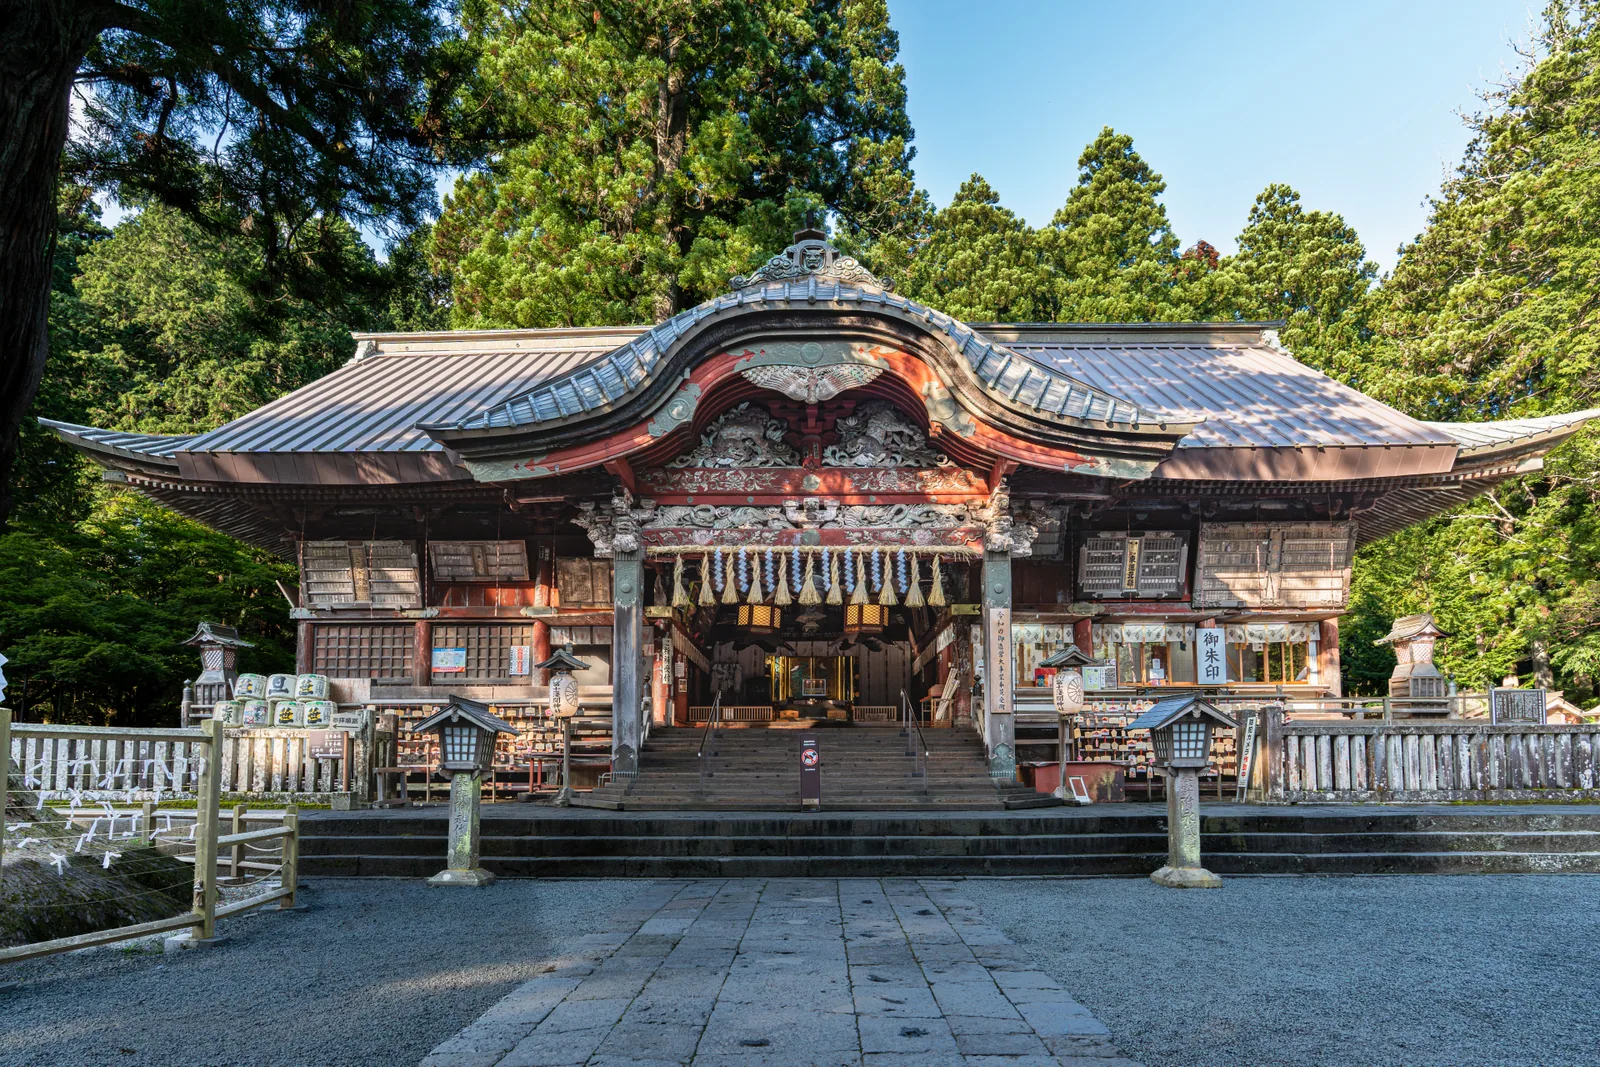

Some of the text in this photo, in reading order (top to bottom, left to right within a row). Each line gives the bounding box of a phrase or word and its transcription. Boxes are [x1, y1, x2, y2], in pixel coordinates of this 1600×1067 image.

[1203, 632, 1220, 680] 御朱印
[1241, 719, 1254, 777] 防犯カメラ作動中
